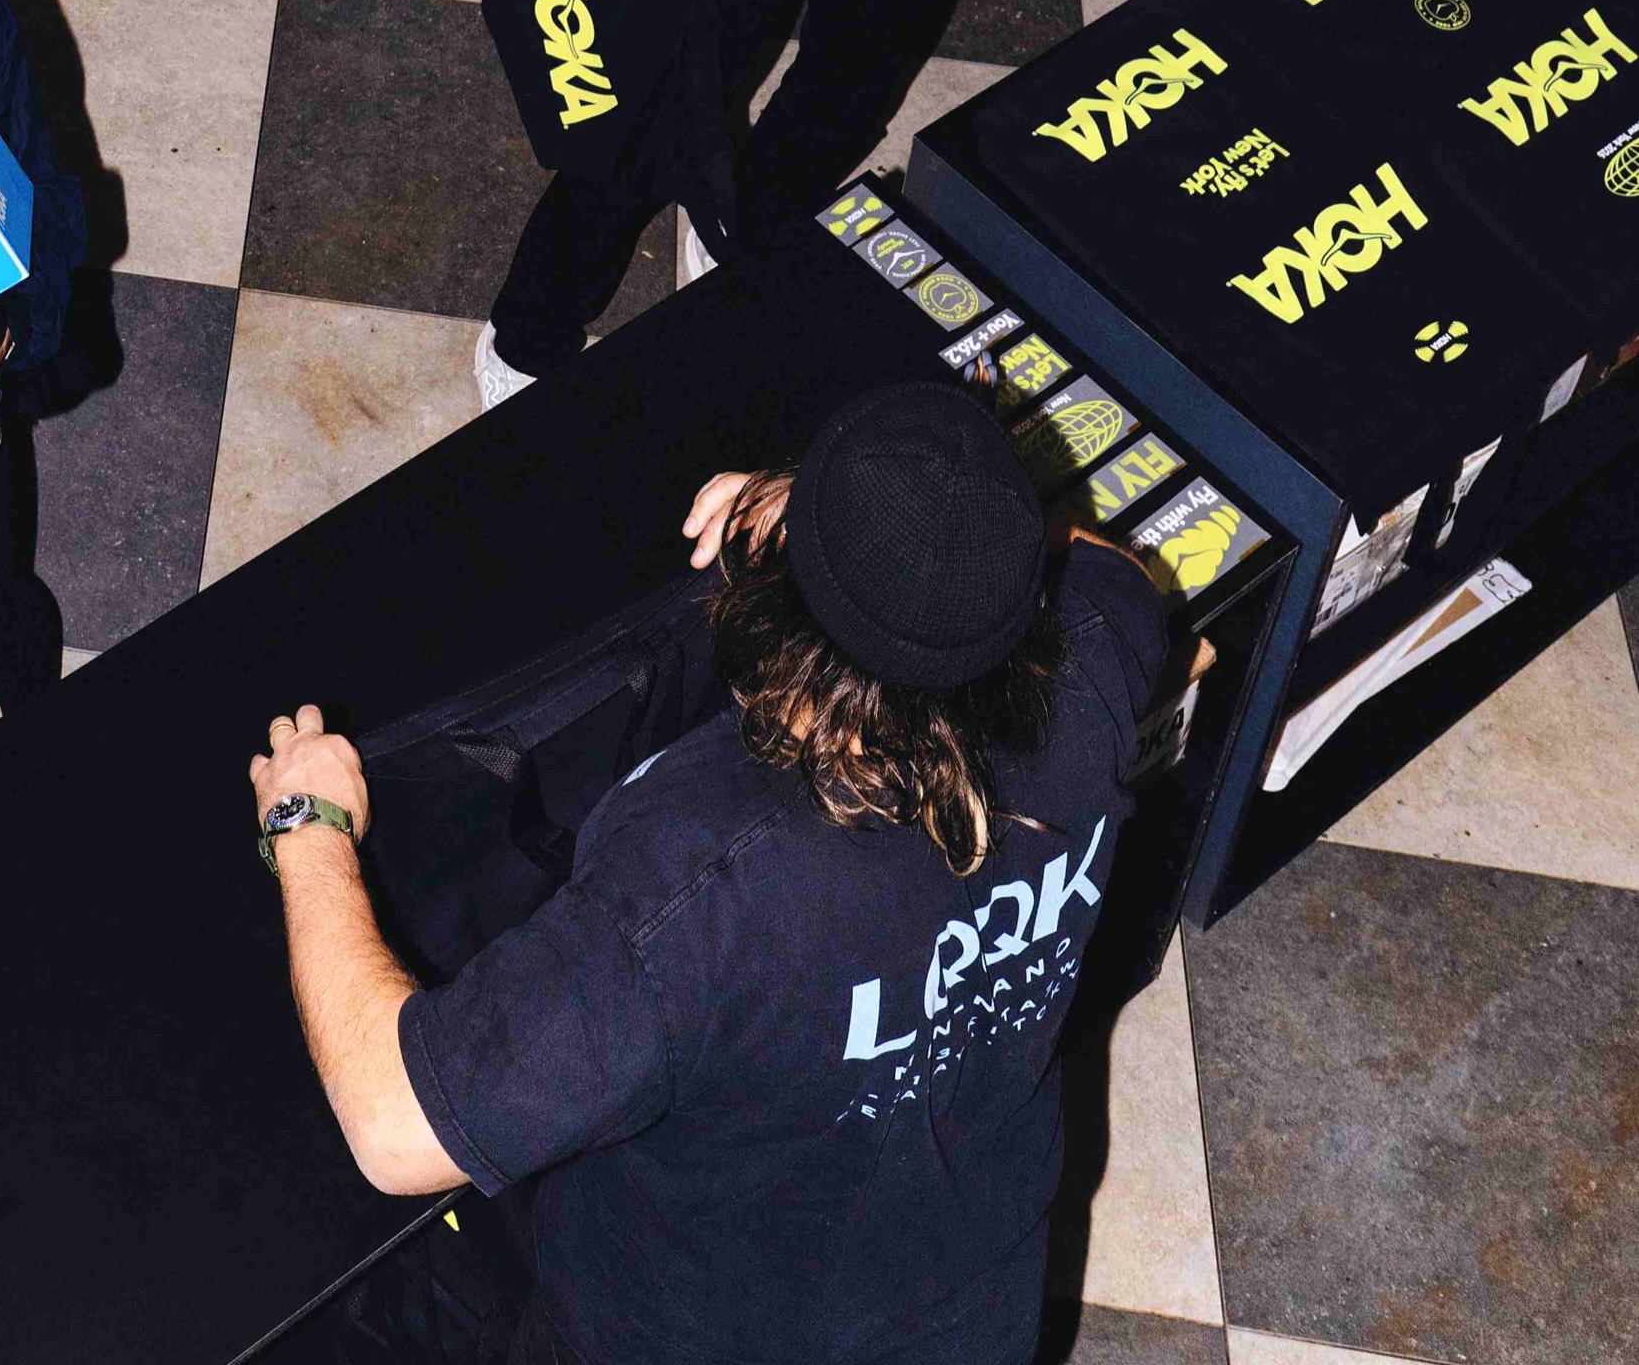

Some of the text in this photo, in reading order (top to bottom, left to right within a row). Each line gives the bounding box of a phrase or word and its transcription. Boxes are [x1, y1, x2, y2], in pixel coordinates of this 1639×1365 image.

[1035, 29, 1226, 161] HOKA
[1461, 9, 1637, 145] HOKA
[1182, 129, 1270, 193] New York
[1209, 142, 1288, 196] Let's fly,
[844, 208, 866, 224] HOKA
[1230, 164, 1426, 322] HOKA
[944, 314, 1019, 363] You + 26.2
[1001, 337, 1050, 370] New
[1430, 333, 1452, 350] HOKA
[1014, 353, 1067, 390] Let's
[1049, 392, 1073, 411] New
[1111, 442, 1175, 497] FLY
[1129, 485, 1219, 554] Fly with the
